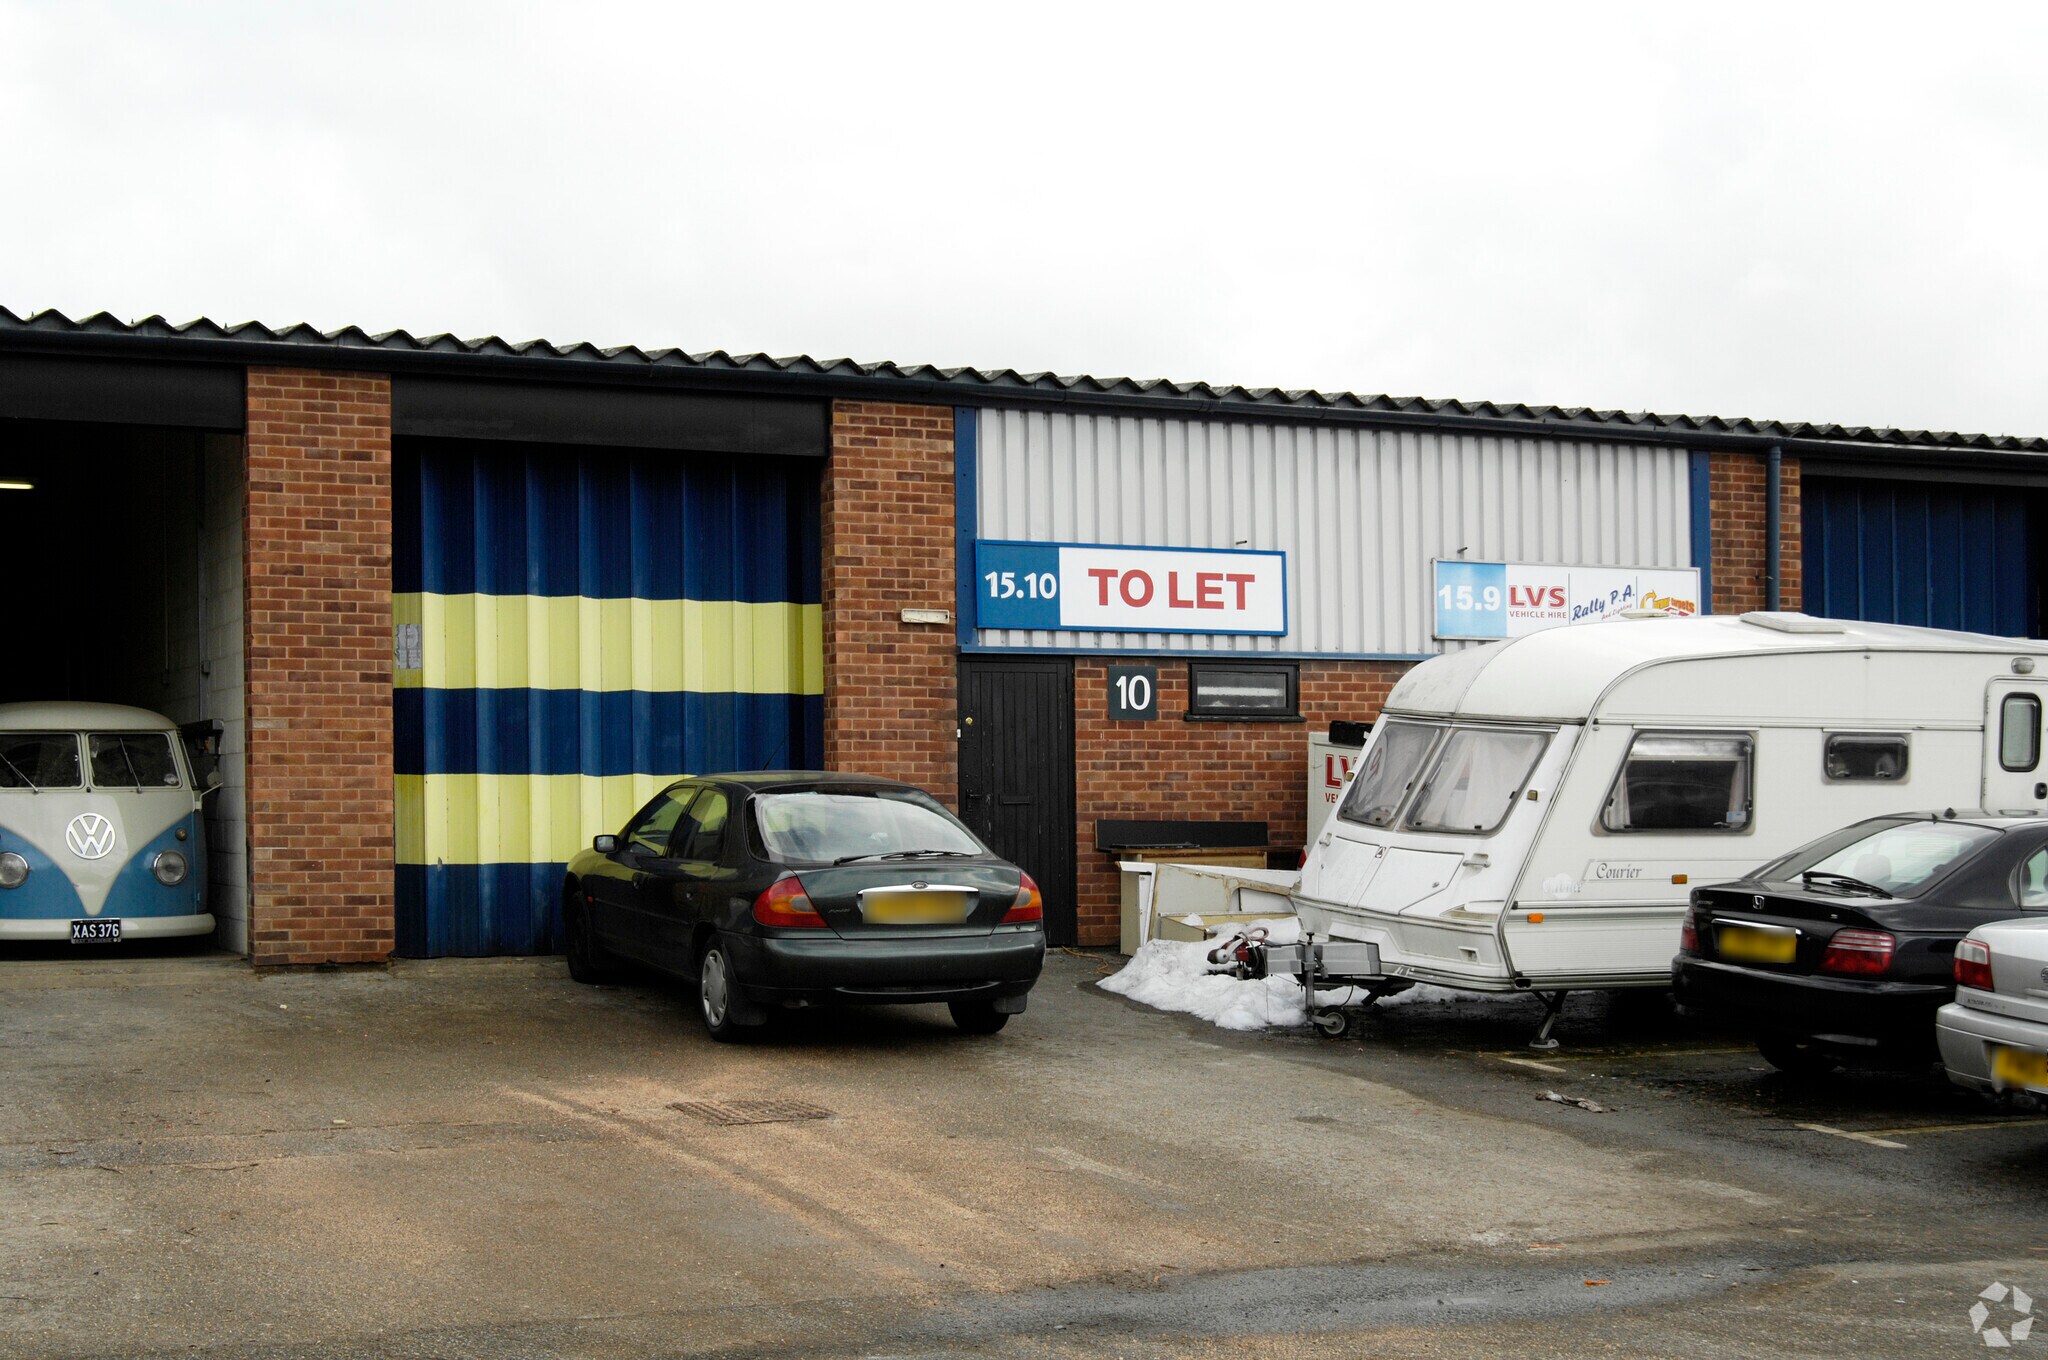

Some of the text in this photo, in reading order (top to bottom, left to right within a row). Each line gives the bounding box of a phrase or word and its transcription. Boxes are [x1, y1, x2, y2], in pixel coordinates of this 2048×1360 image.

[984, 571, 1057, 599] 15.10
[1088, 568, 1256, 611] TO LET
[1438, 584, 1501, 612] 15.9
[1509, 585, 1566, 609] LVS
[1509, 610, 1567, 619] VEHICLE HIRE
[1572, 584, 1635, 621] Rally P.A.
[1115, 674, 1151, 710] 10
[1325, 753, 1357, 789] LV
[1596, 862, 1642, 879] Courier
[73, 923, 119, 938] XAS 376
